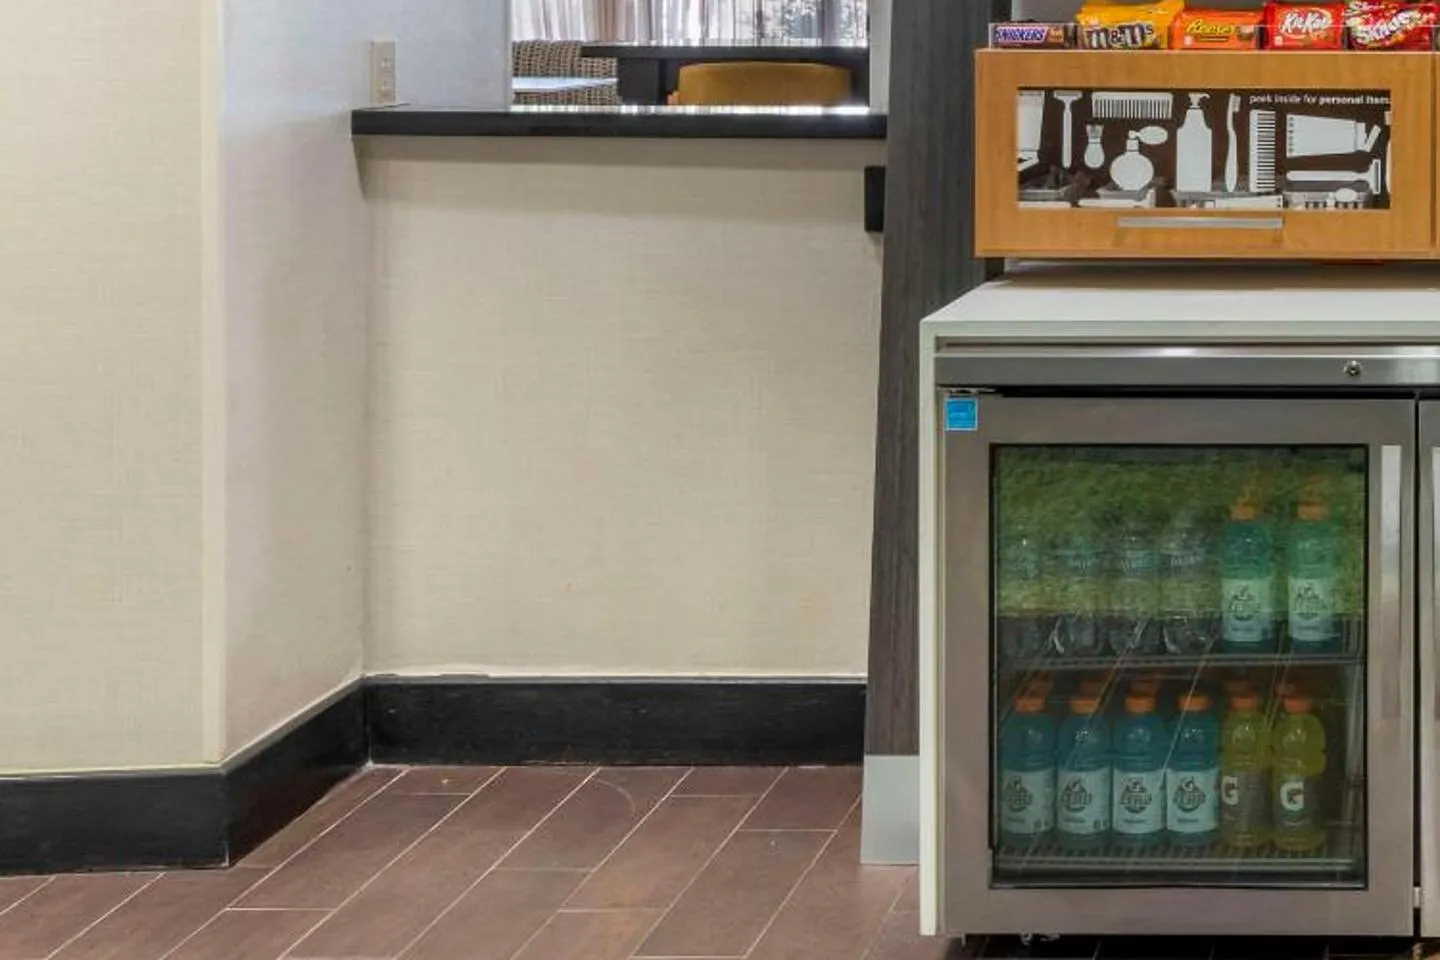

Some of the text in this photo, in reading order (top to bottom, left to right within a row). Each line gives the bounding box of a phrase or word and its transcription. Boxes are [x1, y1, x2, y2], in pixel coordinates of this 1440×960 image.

[996, 27, 1045, 41] SNICKERS
[1275, 94, 1300, 103] inside
[1303, 94, 1317, 103] for
[1319, 95, 1364, 105] personal
[1221, 775, 1239, 806] G
[1280, 782, 1304, 812] G
